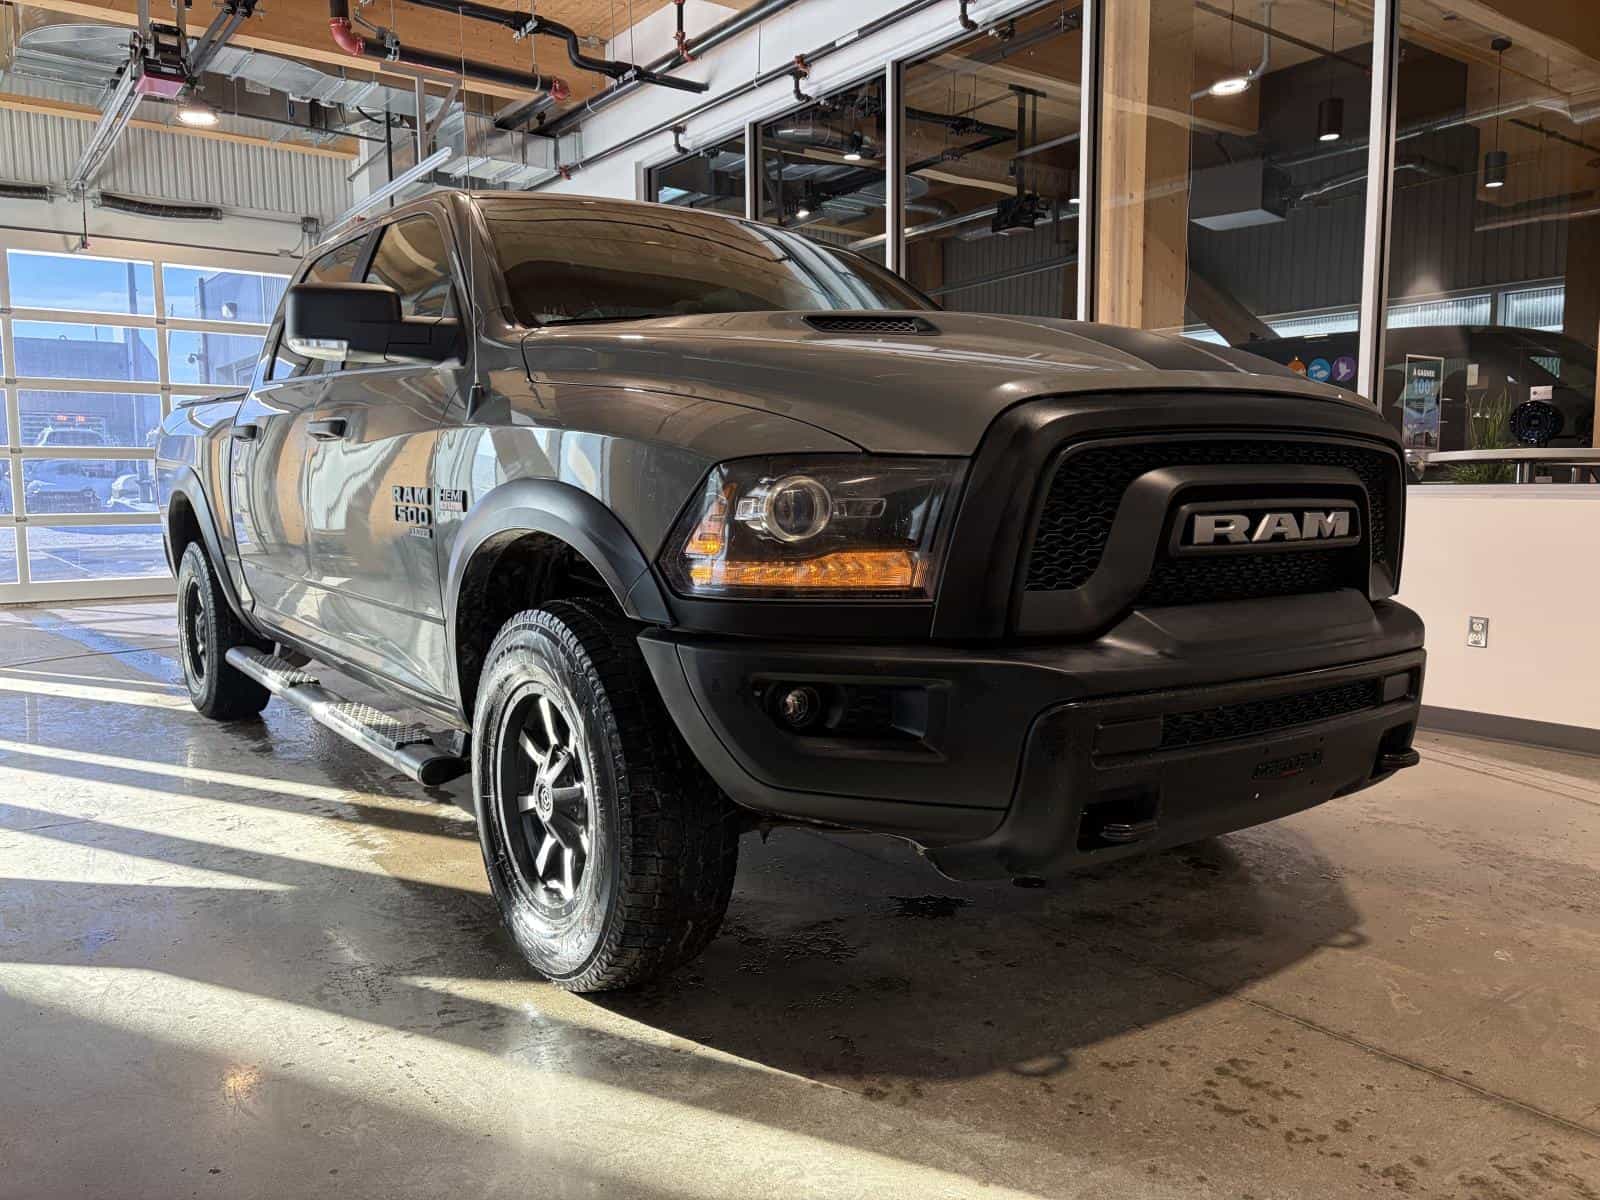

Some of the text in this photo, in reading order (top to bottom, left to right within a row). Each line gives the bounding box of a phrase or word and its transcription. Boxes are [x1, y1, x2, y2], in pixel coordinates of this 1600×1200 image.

[392, 486, 430, 505] RAM
[440, 488, 464, 502] HEMI
[1193, 511, 1350, 544] RAM
